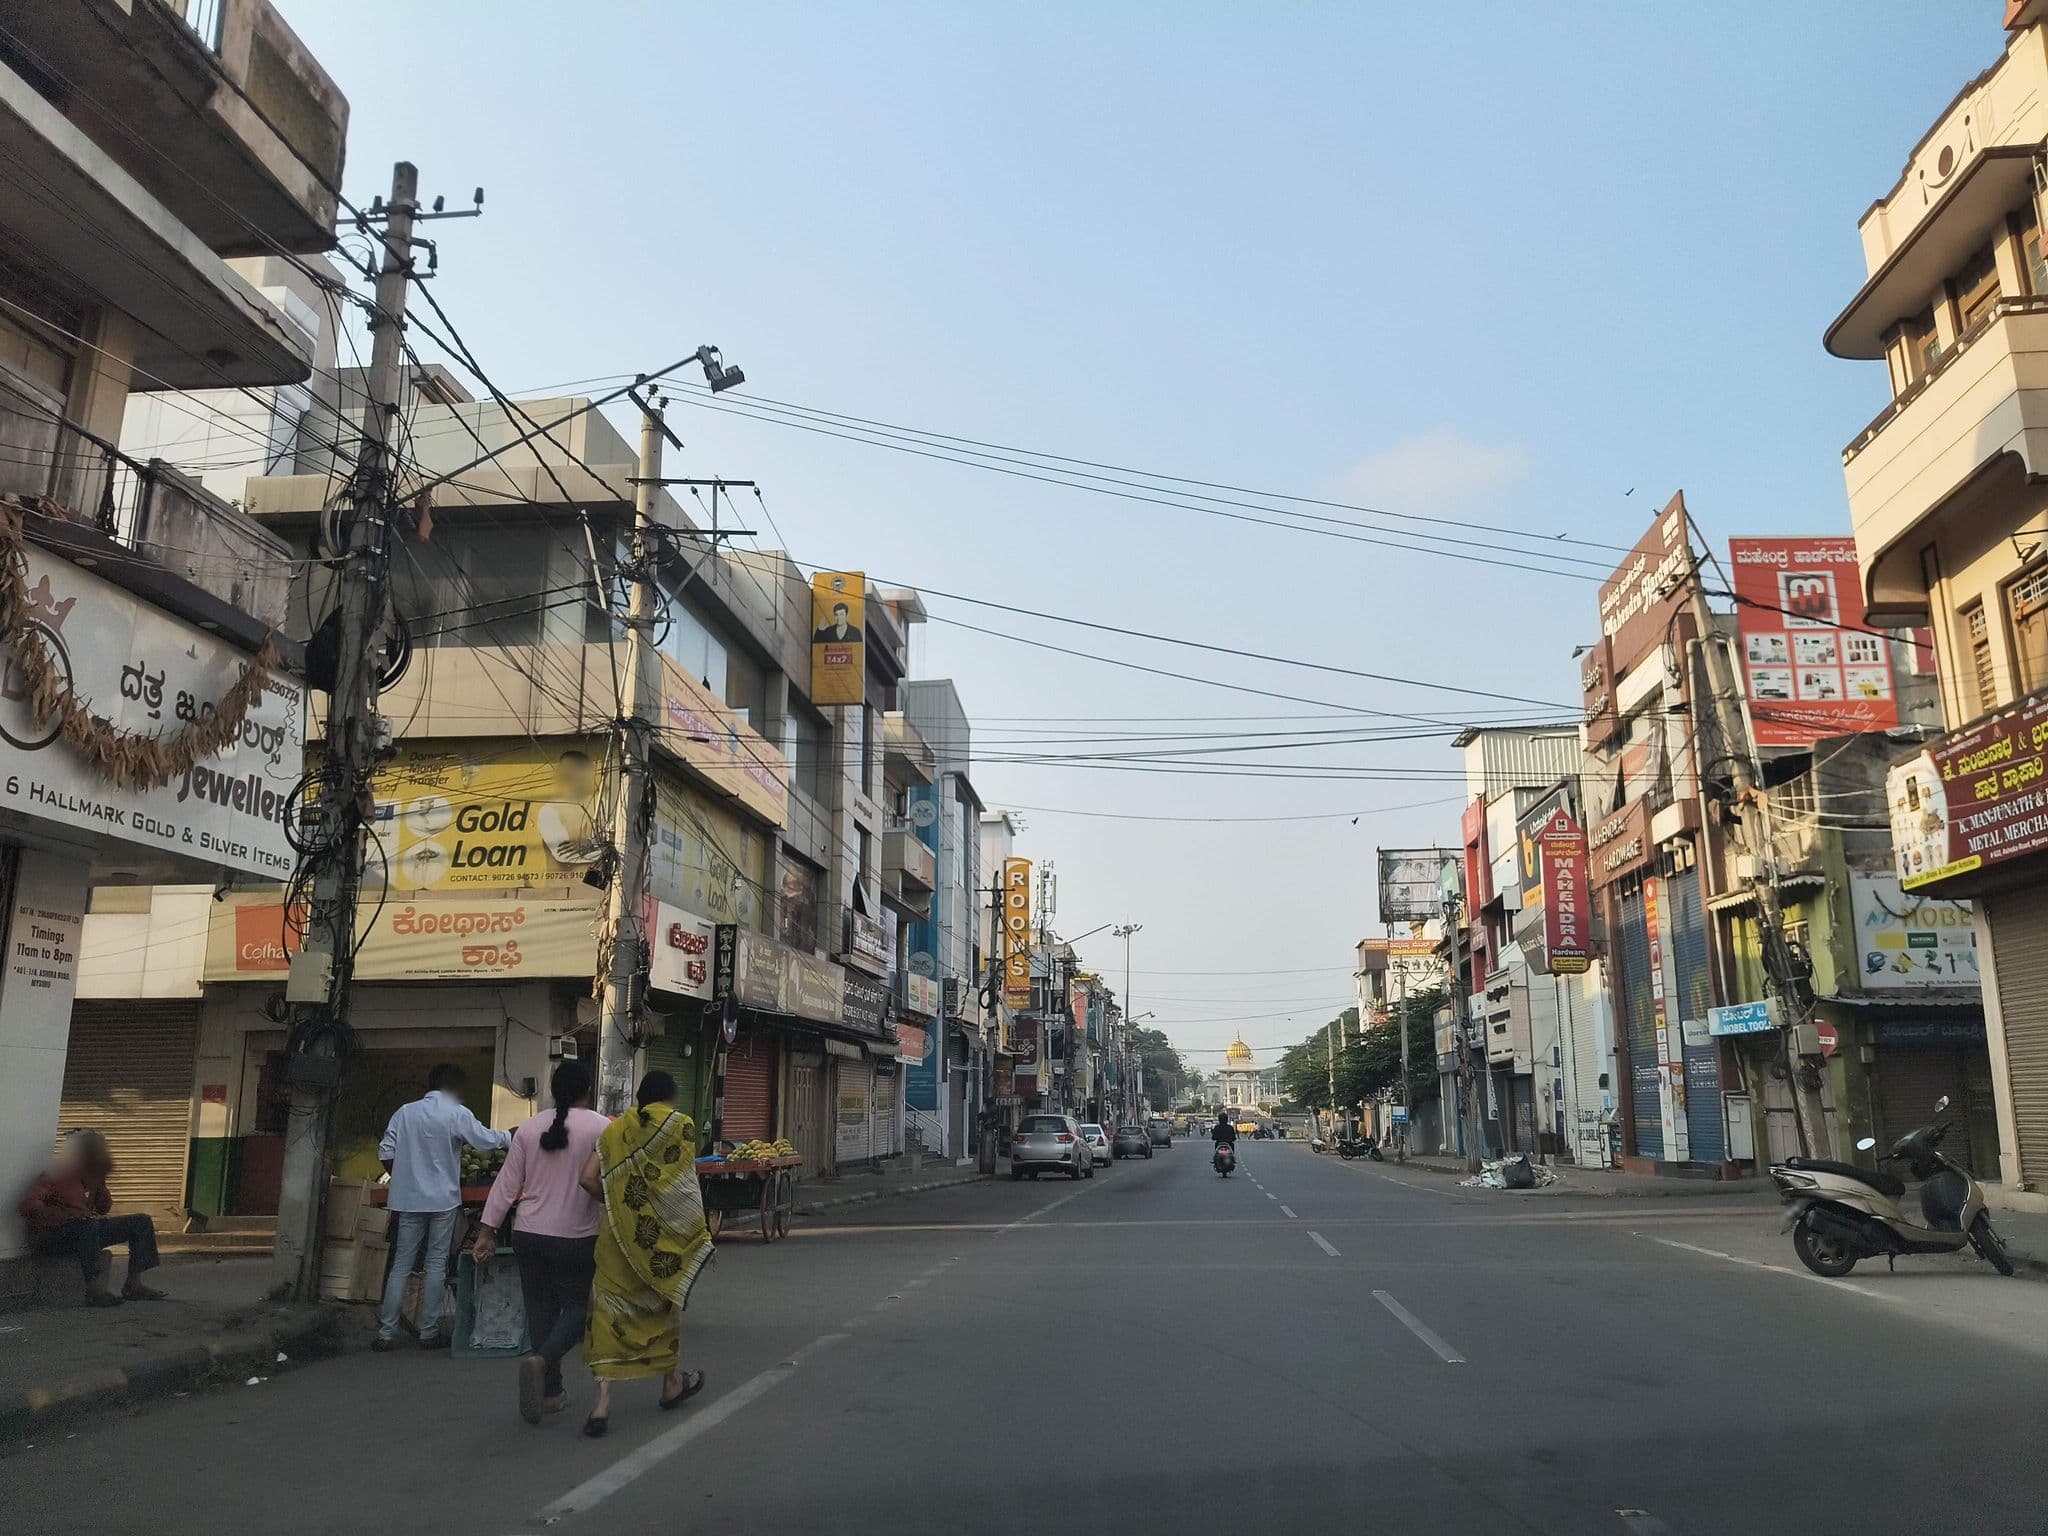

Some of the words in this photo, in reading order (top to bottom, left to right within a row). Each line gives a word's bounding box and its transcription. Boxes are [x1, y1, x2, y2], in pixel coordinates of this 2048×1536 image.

[456, 802, 531, 833] Gold
[1969, 793, 2034, 830] MANJUNATH
[2035, 790, 2044, 807] &
[30, 782, 125, 826] HALLMARK
[132, 811, 176, 839] GOLD
[181, 827, 193, 844] &
[200, 832, 248, 860] SILVER
[253, 847, 291, 870] ITEMS
[1967, 829, 2003, 853] METAL
[451, 840, 527, 868] Loan
[1603, 837, 1643, 872] HARDWARE
[1554, 858, 1578, 946] MAHENDRA
[31, 925, 65, 945] Timings
[1010, 872, 1026, 976] ROOMS
[17, 943, 38, 958] 11am
[41, 947, 51, 960] to
[53, 948, 73, 964] 8pm
[461, 939, 523, 969] ಕಾಫಿ
[1551, 948, 1586, 956] Hardware
[1723, 1023, 1748, 1033] NOBEL
